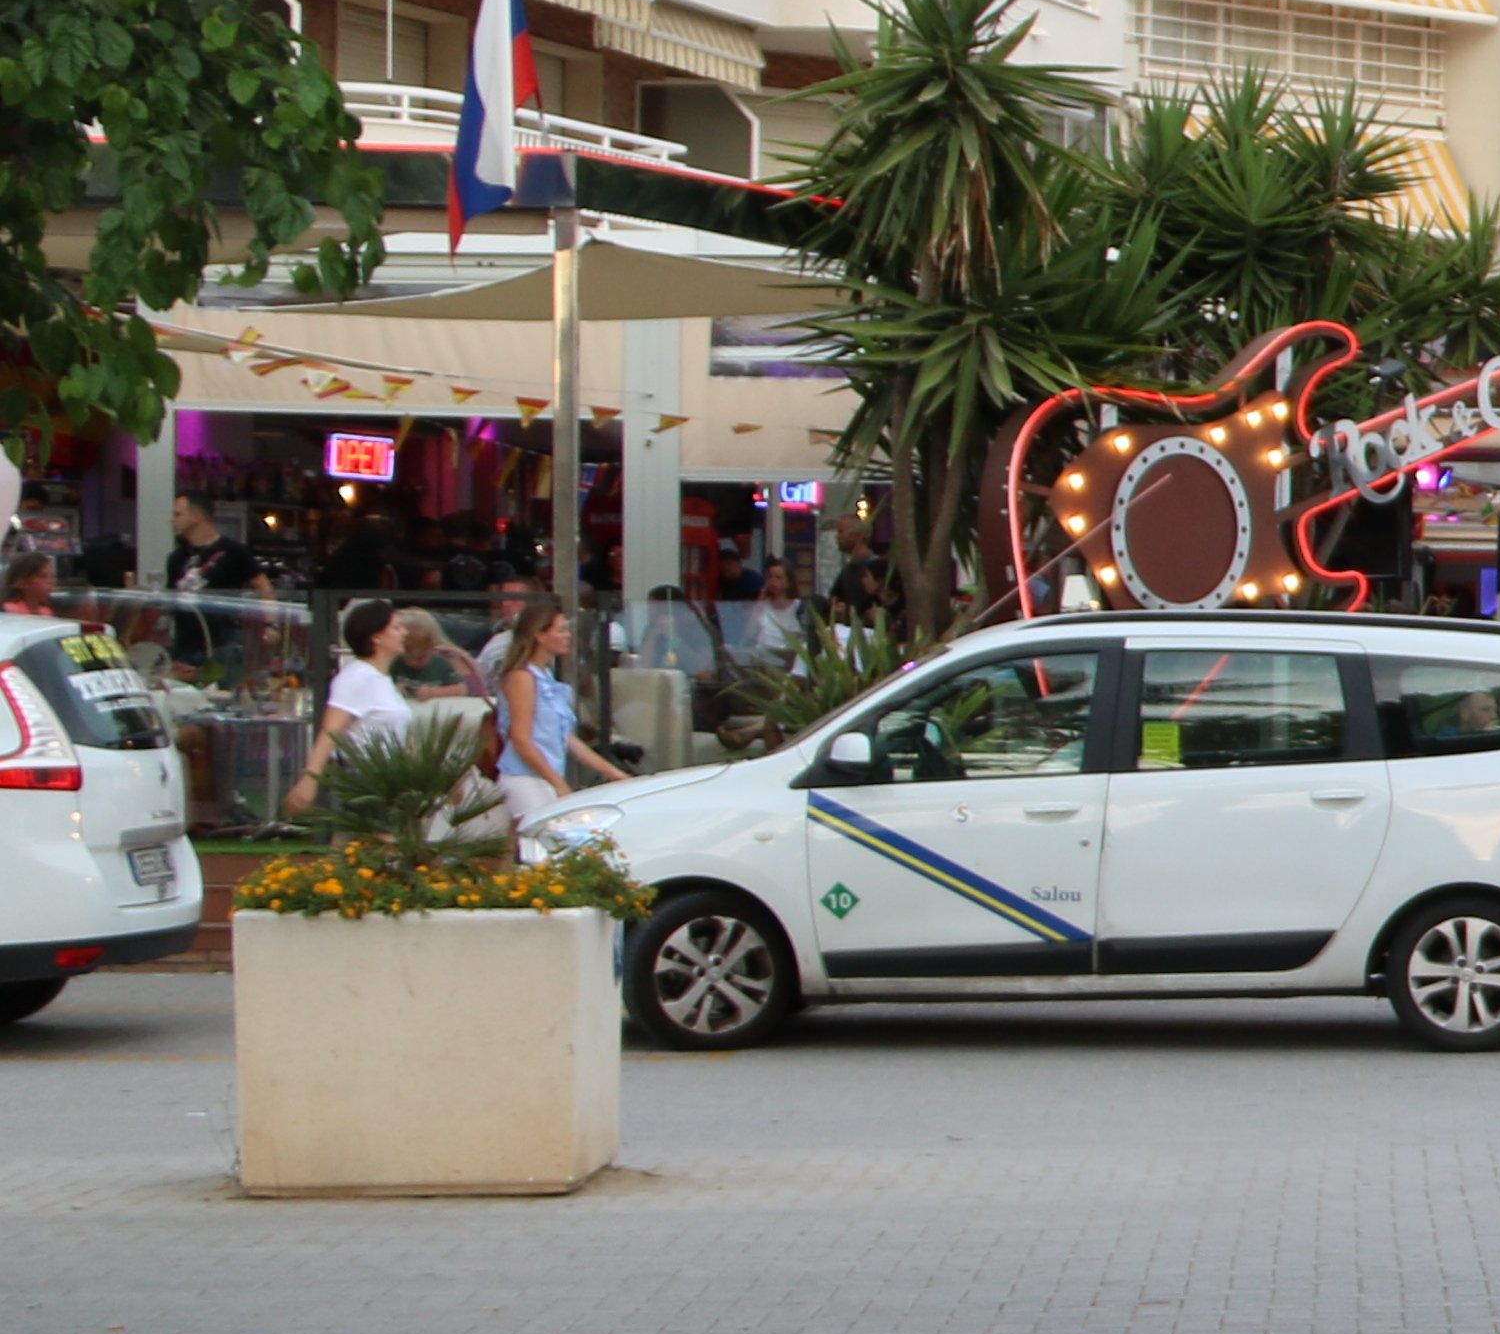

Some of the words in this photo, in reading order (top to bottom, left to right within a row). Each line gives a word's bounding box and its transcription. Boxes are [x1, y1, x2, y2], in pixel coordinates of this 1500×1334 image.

[335, 440, 386, 475] OPEN
[1309, 393, 1444, 503] Rock
[1452, 401, 1477, 437] &
[827, 893, 851, 910] 10
[1031, 886, 1082, 903] Salou
